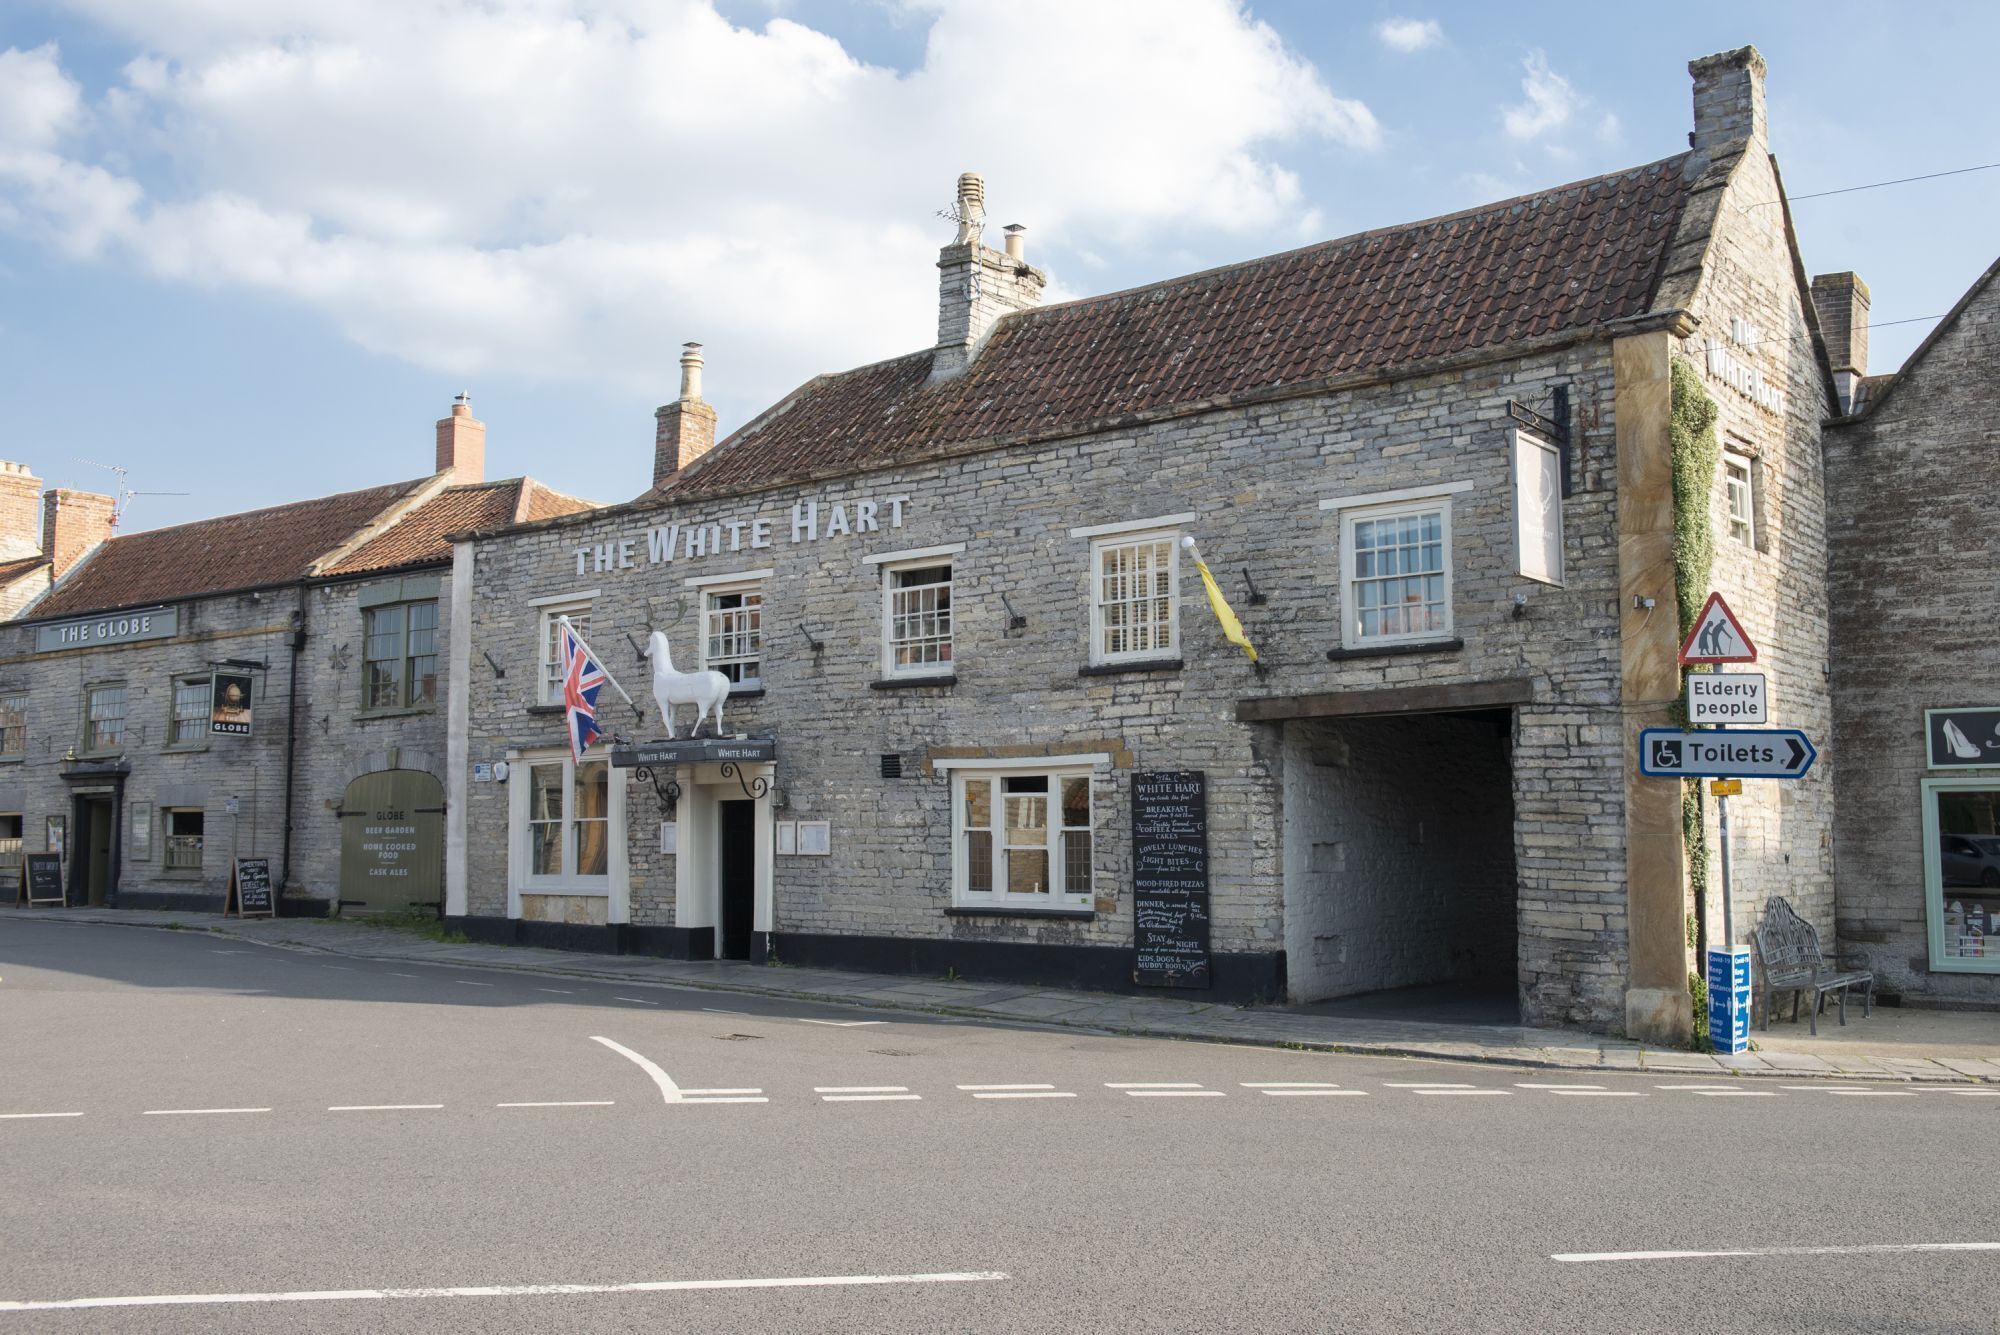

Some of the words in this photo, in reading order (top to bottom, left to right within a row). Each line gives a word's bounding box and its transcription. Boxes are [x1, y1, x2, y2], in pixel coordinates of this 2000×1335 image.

[1731, 314, 1758, 354] THE
[1706, 337, 1752, 397] WHITE
[1752, 368, 1785, 417] HART
[573, 540, 636, 575] THE
[648, 518, 771, 564] WHITE
[791, 495, 910, 543] HART
[61, 625, 89, 643] THE
[98, 617, 151, 638] GLOBE
[1695, 682, 1758, 697] Elderly
[1697, 701, 1758, 716] people
[215, 724, 248, 732] GLOBE
[660, 752, 678, 761] HART
[718, 749, 740, 758] WHITE
[742, 749, 760, 758] HART
[1689, 744, 1774, 763] Toilets
[1138, 784, 1172, 793] WHITE
[1175, 783, 1200, 794] HART
[377, 811, 405, 820] GLOBE
[1139, 843, 1166, 854] LOVELY
[1168, 844, 1203, 854] LUNCHES
[1143, 856, 1164, 865] LIGHT
[1136, 880, 1179, 888] WOOD-FIRED
[1137, 901, 1166, 909] DINNER
[1710, 956, 1731, 964] Covid-19
[1710, 967, 1723, 975] Keep
[1710, 983, 1732, 993] distance
